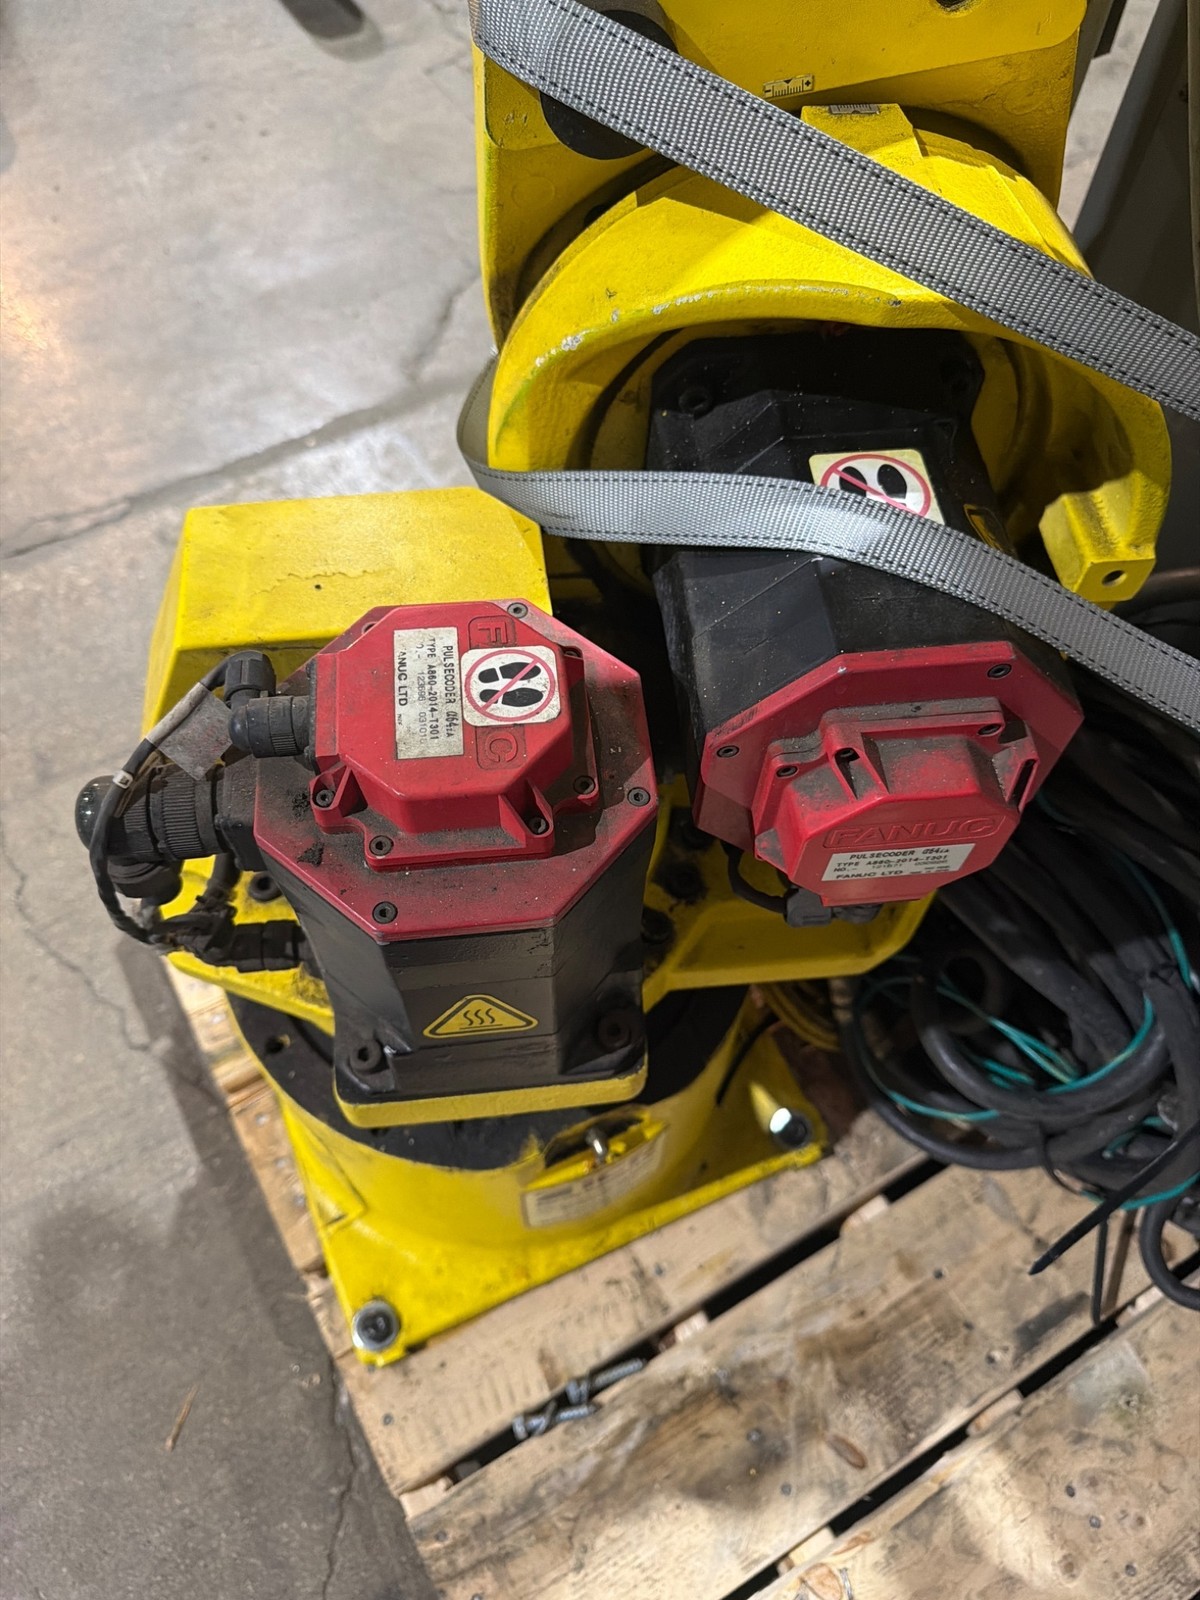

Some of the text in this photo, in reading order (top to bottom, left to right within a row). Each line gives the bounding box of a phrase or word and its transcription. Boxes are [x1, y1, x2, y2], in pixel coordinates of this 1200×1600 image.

[397, 650, 408, 683] ANUC
[442, 645, 456, 704] PULSECODER
[397, 685, 408, 707] LTD
[426, 637, 439, 740] TYPE A860-2014-T301
[830, 817, 996, 846] FANUC
[849, 849, 915, 860] PULSECODER
[835, 871, 877, 879] FANUC
